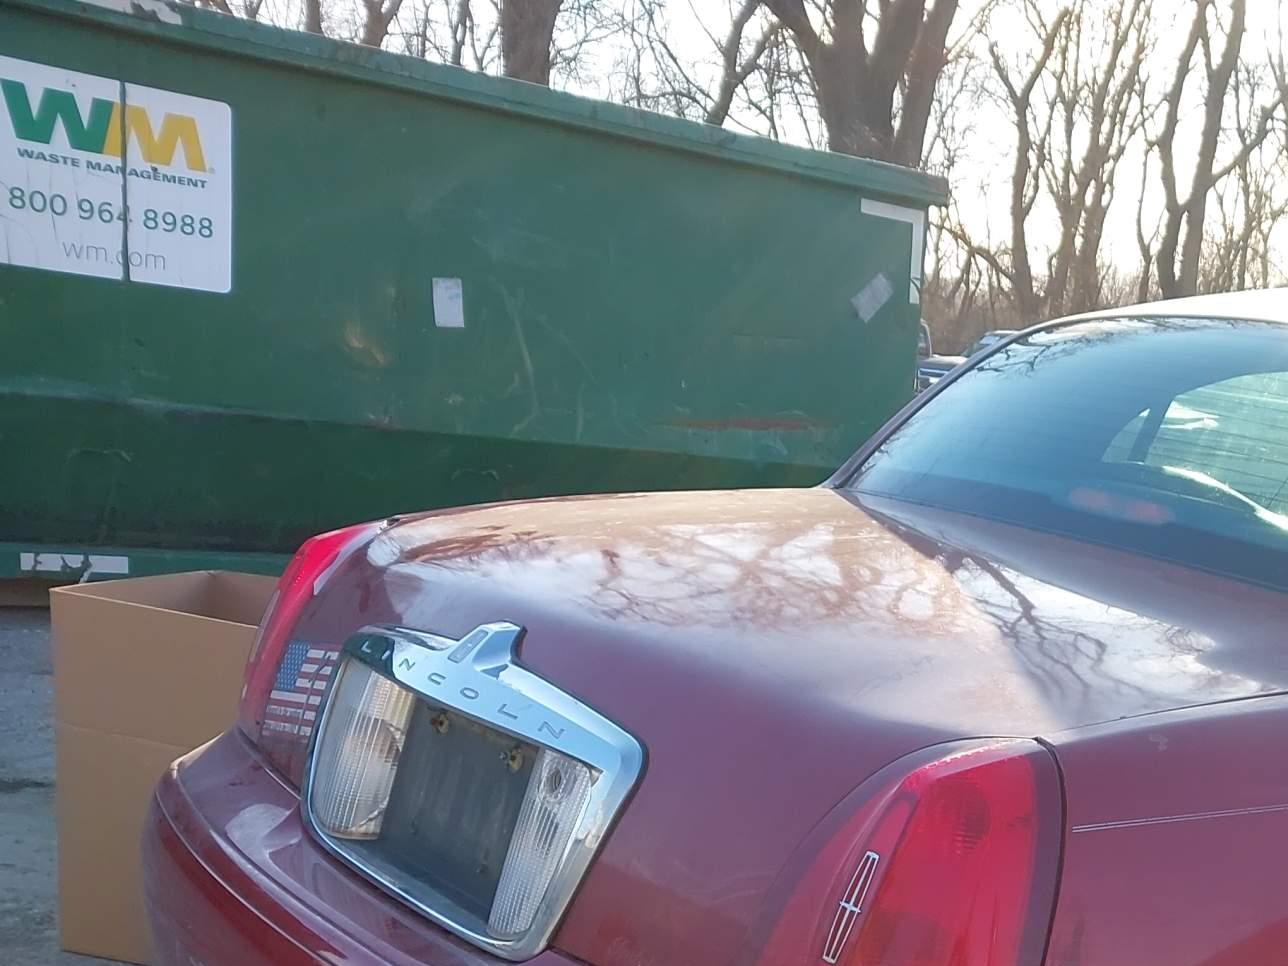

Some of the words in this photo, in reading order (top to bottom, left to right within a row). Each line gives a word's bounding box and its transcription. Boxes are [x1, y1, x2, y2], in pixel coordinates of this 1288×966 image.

[16, 146, 80, 168] WASTE
[86, 159, 208, 189] MANAGEMENT
[8, 186, 68, 216] 800
[143, 208, 214, 239] 8988
[62, 241, 167, 271] wm.com
[361, 639, 566, 741] LINCOLN
